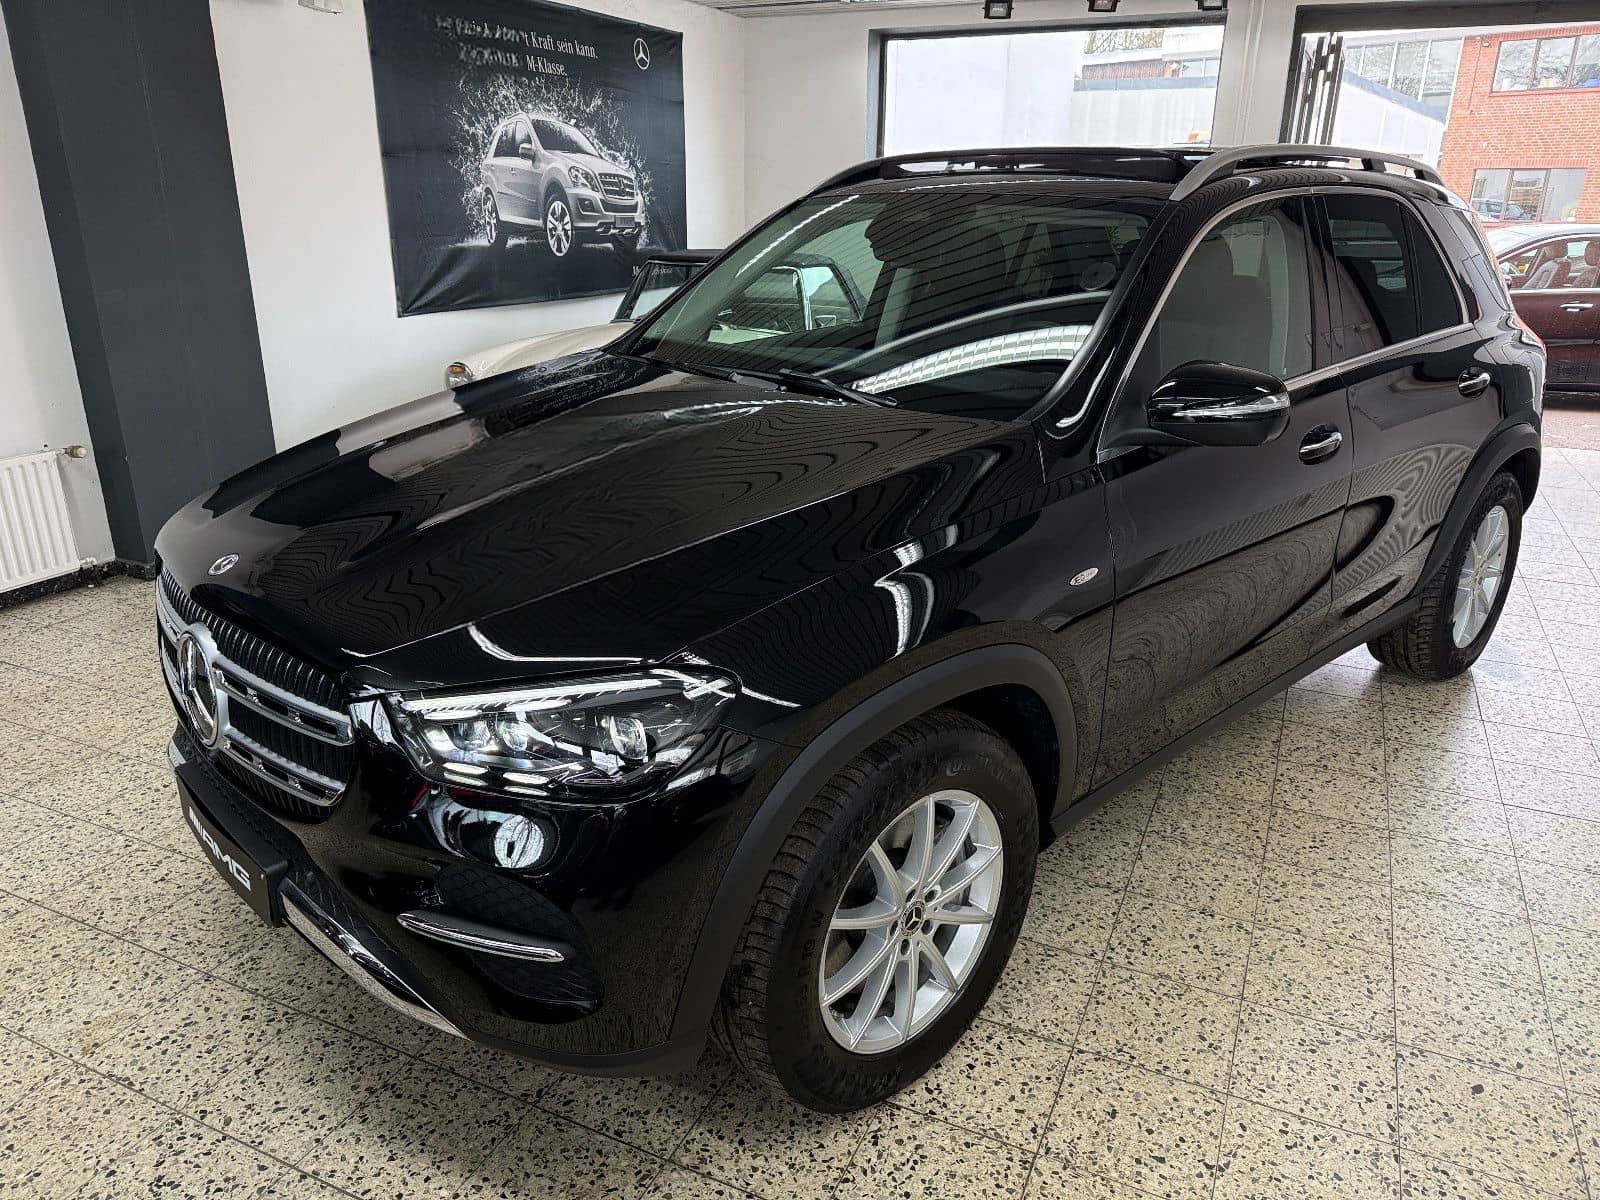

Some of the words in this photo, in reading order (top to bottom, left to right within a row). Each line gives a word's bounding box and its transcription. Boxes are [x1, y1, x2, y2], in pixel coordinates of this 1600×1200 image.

[530, 31, 555, 51] Kraft
[556, 38, 574, 54] sein
[574, 39, 598, 59] kann.
[525, 54, 568, 76] M-Klasse.
[201, 826, 252, 891] AMG
